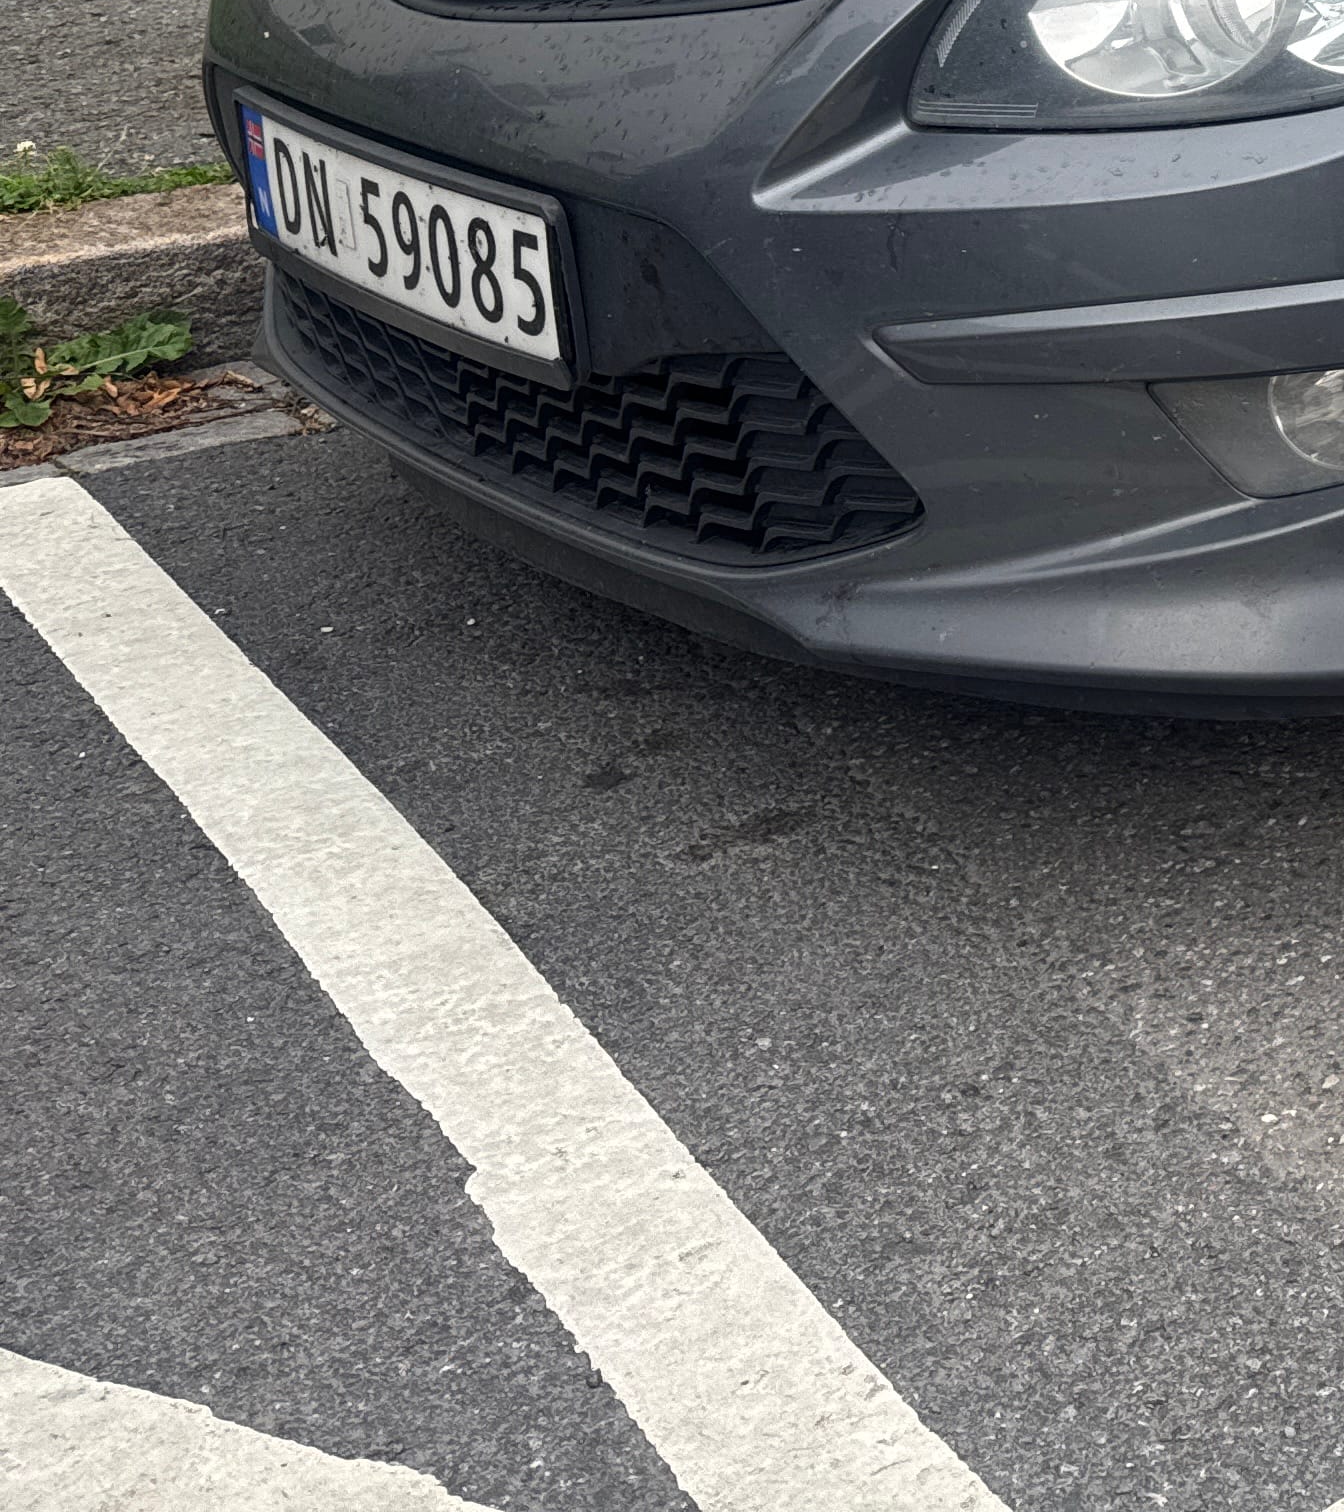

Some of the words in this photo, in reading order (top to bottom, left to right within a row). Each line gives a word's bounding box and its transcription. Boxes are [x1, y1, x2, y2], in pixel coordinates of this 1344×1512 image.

[258, 187, 271, 217] N
[274, 137, 338, 258] DN
[360, 176, 547, 336] 59085
